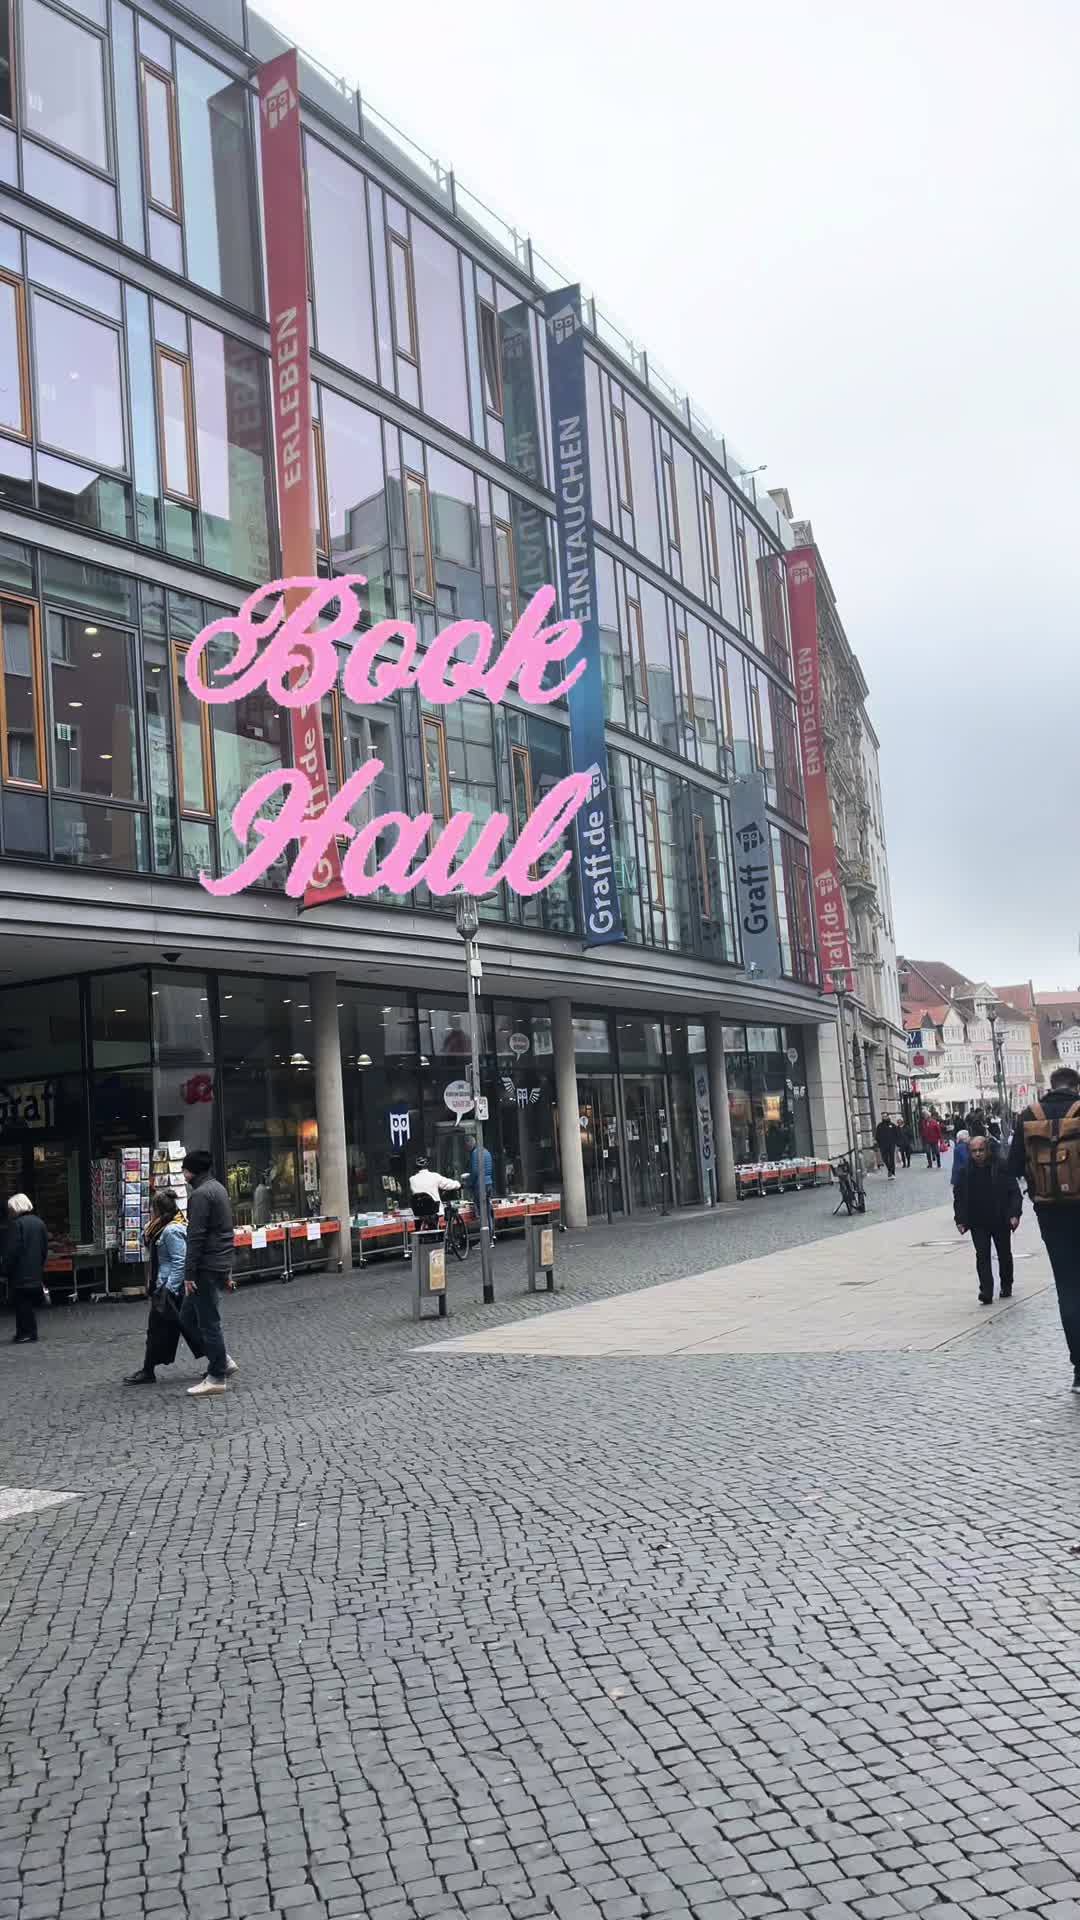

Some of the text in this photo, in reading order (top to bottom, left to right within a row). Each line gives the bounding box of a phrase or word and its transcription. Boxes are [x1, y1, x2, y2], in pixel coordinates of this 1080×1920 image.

[274, 305, 302, 491] ERLEBEN
[558, 415, 592, 623] EINTAUCHEN
[798, 647, 820, 776] ENTDECKEN
[583, 810, 614, 934] Graff.de
[739, 864, 769, 935] Graff
[820, 901, 847, 986] raff.de
